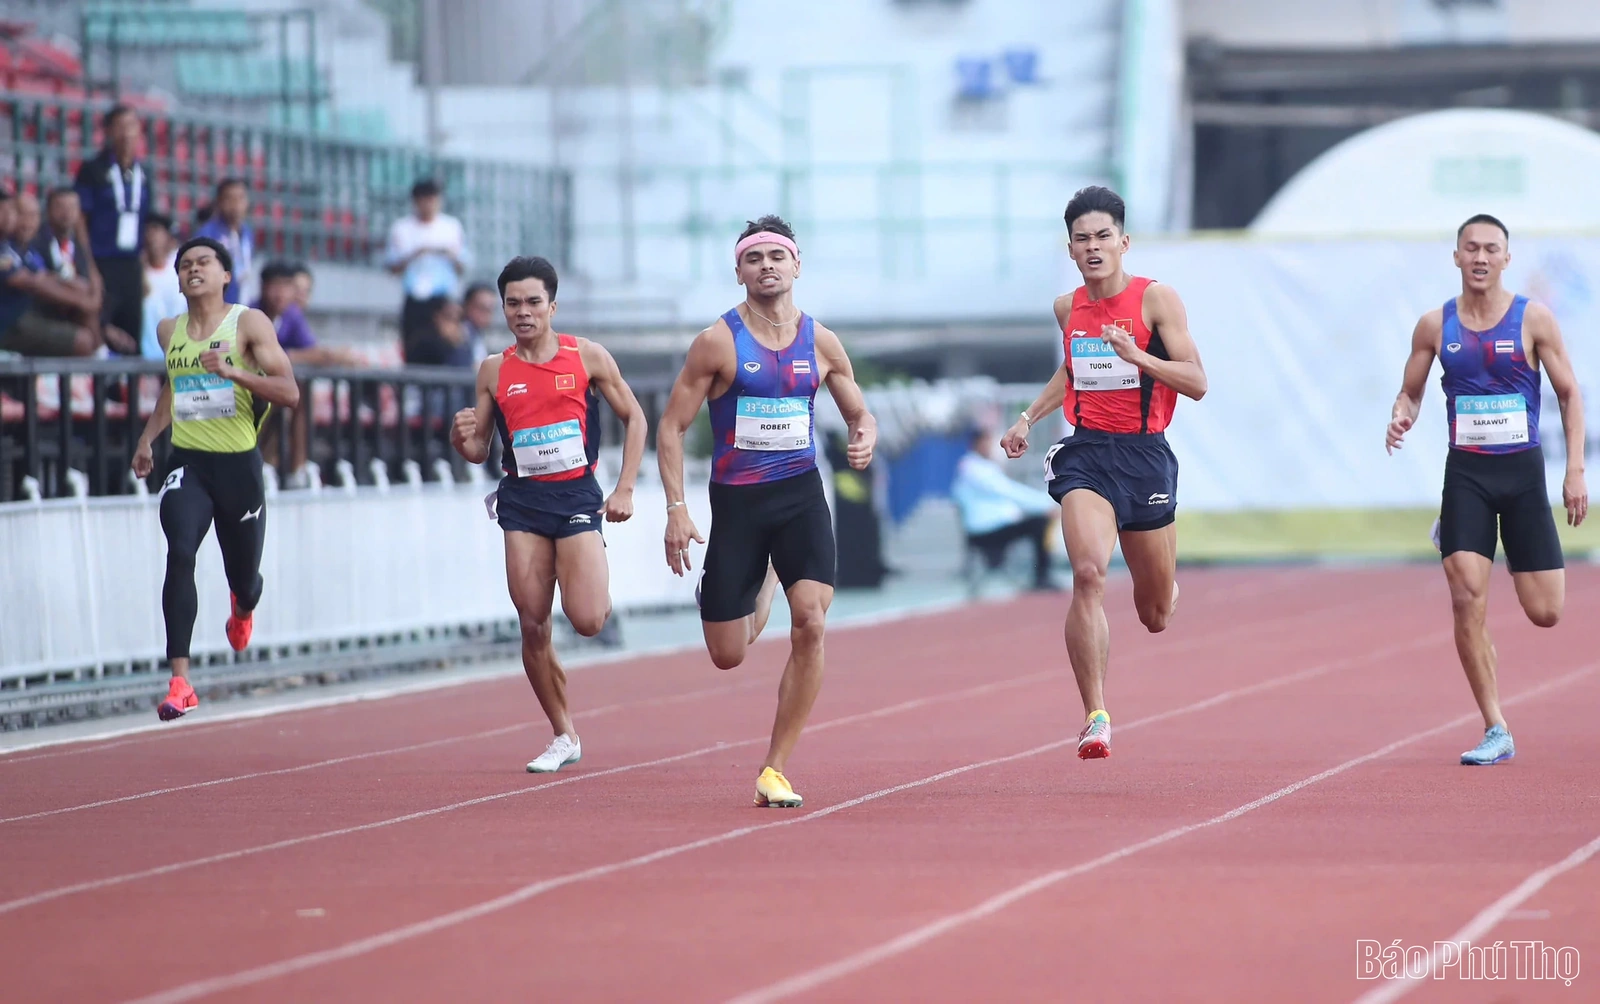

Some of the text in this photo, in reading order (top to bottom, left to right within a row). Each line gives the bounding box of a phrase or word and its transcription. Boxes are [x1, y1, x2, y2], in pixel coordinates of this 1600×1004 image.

[1087, 343, 1099, 352] SEA
[167, 356, 234, 370] MALAA
[760, 403, 777, 413] SEA
[779, 402, 803, 413] GAMES
[1474, 402, 1489, 410] SEA
[1491, 399, 1518, 409] GAMES
[1473, 418, 1508, 426] SARAWUT
[531, 432, 546, 442] SEA
[547, 425, 573, 439] GAMES
[538, 447, 560, 456] PHUC
[571, 457, 583, 465] 284
